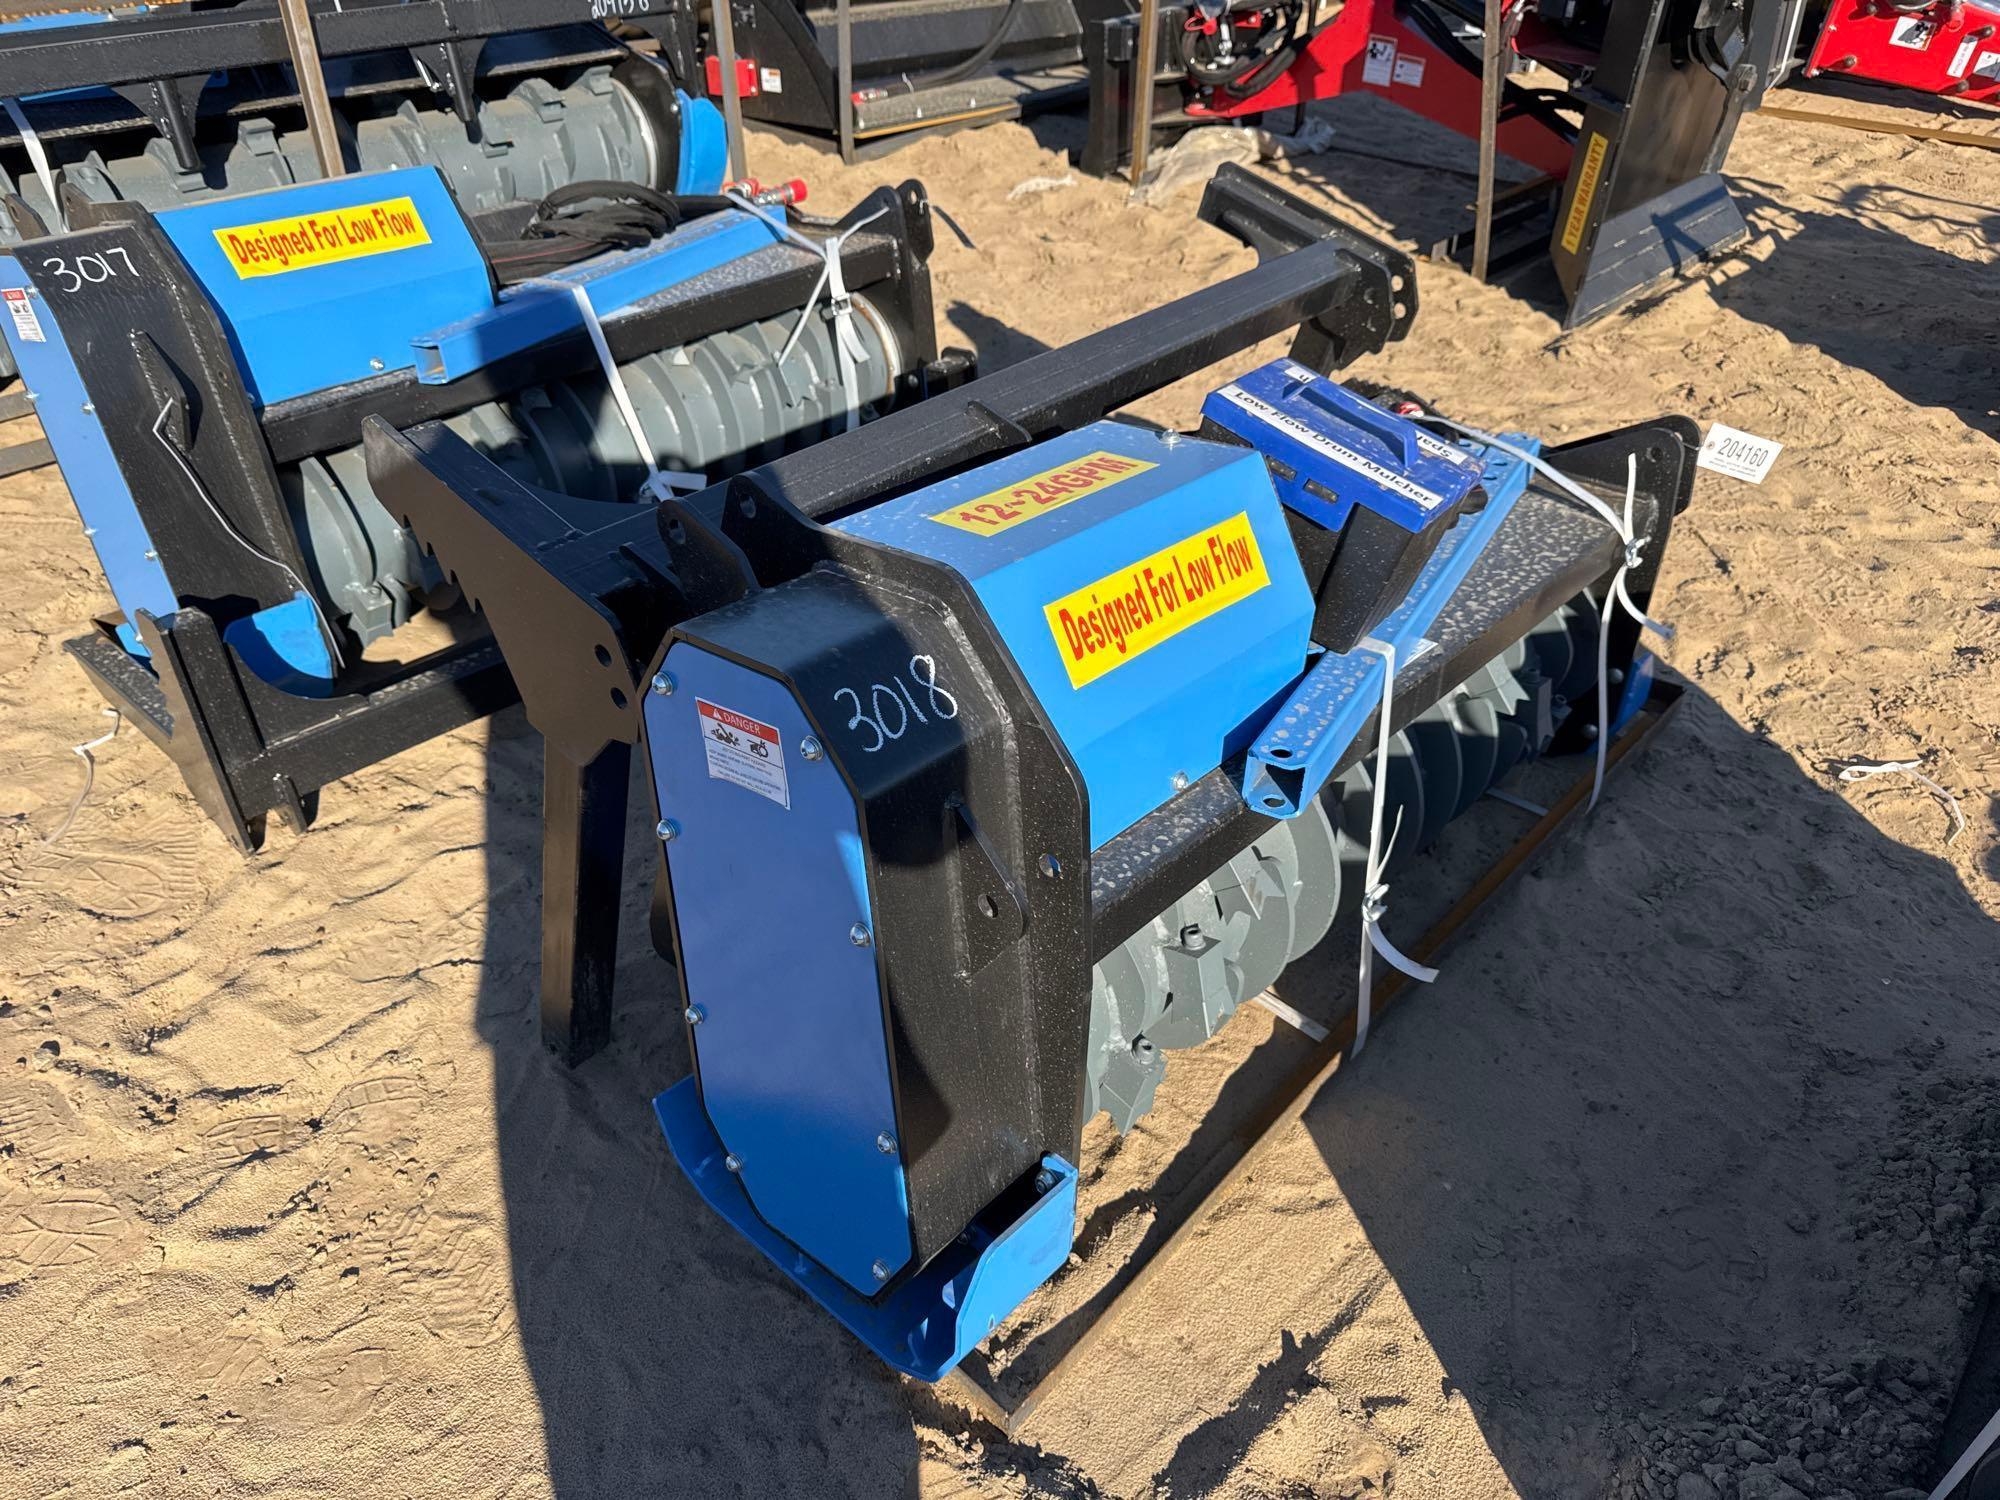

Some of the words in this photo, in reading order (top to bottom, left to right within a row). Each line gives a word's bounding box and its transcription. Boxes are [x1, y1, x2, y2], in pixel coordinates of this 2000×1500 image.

[1567, 206, 1585, 239] YEAR
[1576, 139, 1605, 207] WARRANTY
[42, 247, 140, 293] 3017
[228, 222, 316, 266] Designed
[308, 219, 344, 250] For
[336, 215, 378, 245] Low
[371, 207, 417, 239] Flow
[1235, 392, 1268, 411] Low
[1271, 411, 1309, 433] Flow
[1312, 433, 1358, 461] Drum
[1362, 461, 1433, 502] Mulcher
[1717, 437, 1769, 467] 204160
[1058, 574, 1154, 662] Designed
[1142, 567, 1182, 618] For
[1172, 555, 1216, 603] Low
[1207, 534, 1254, 585] Flow
[723, 712, 761, 734] DANGER
[833, 654, 958, 752] 3018
